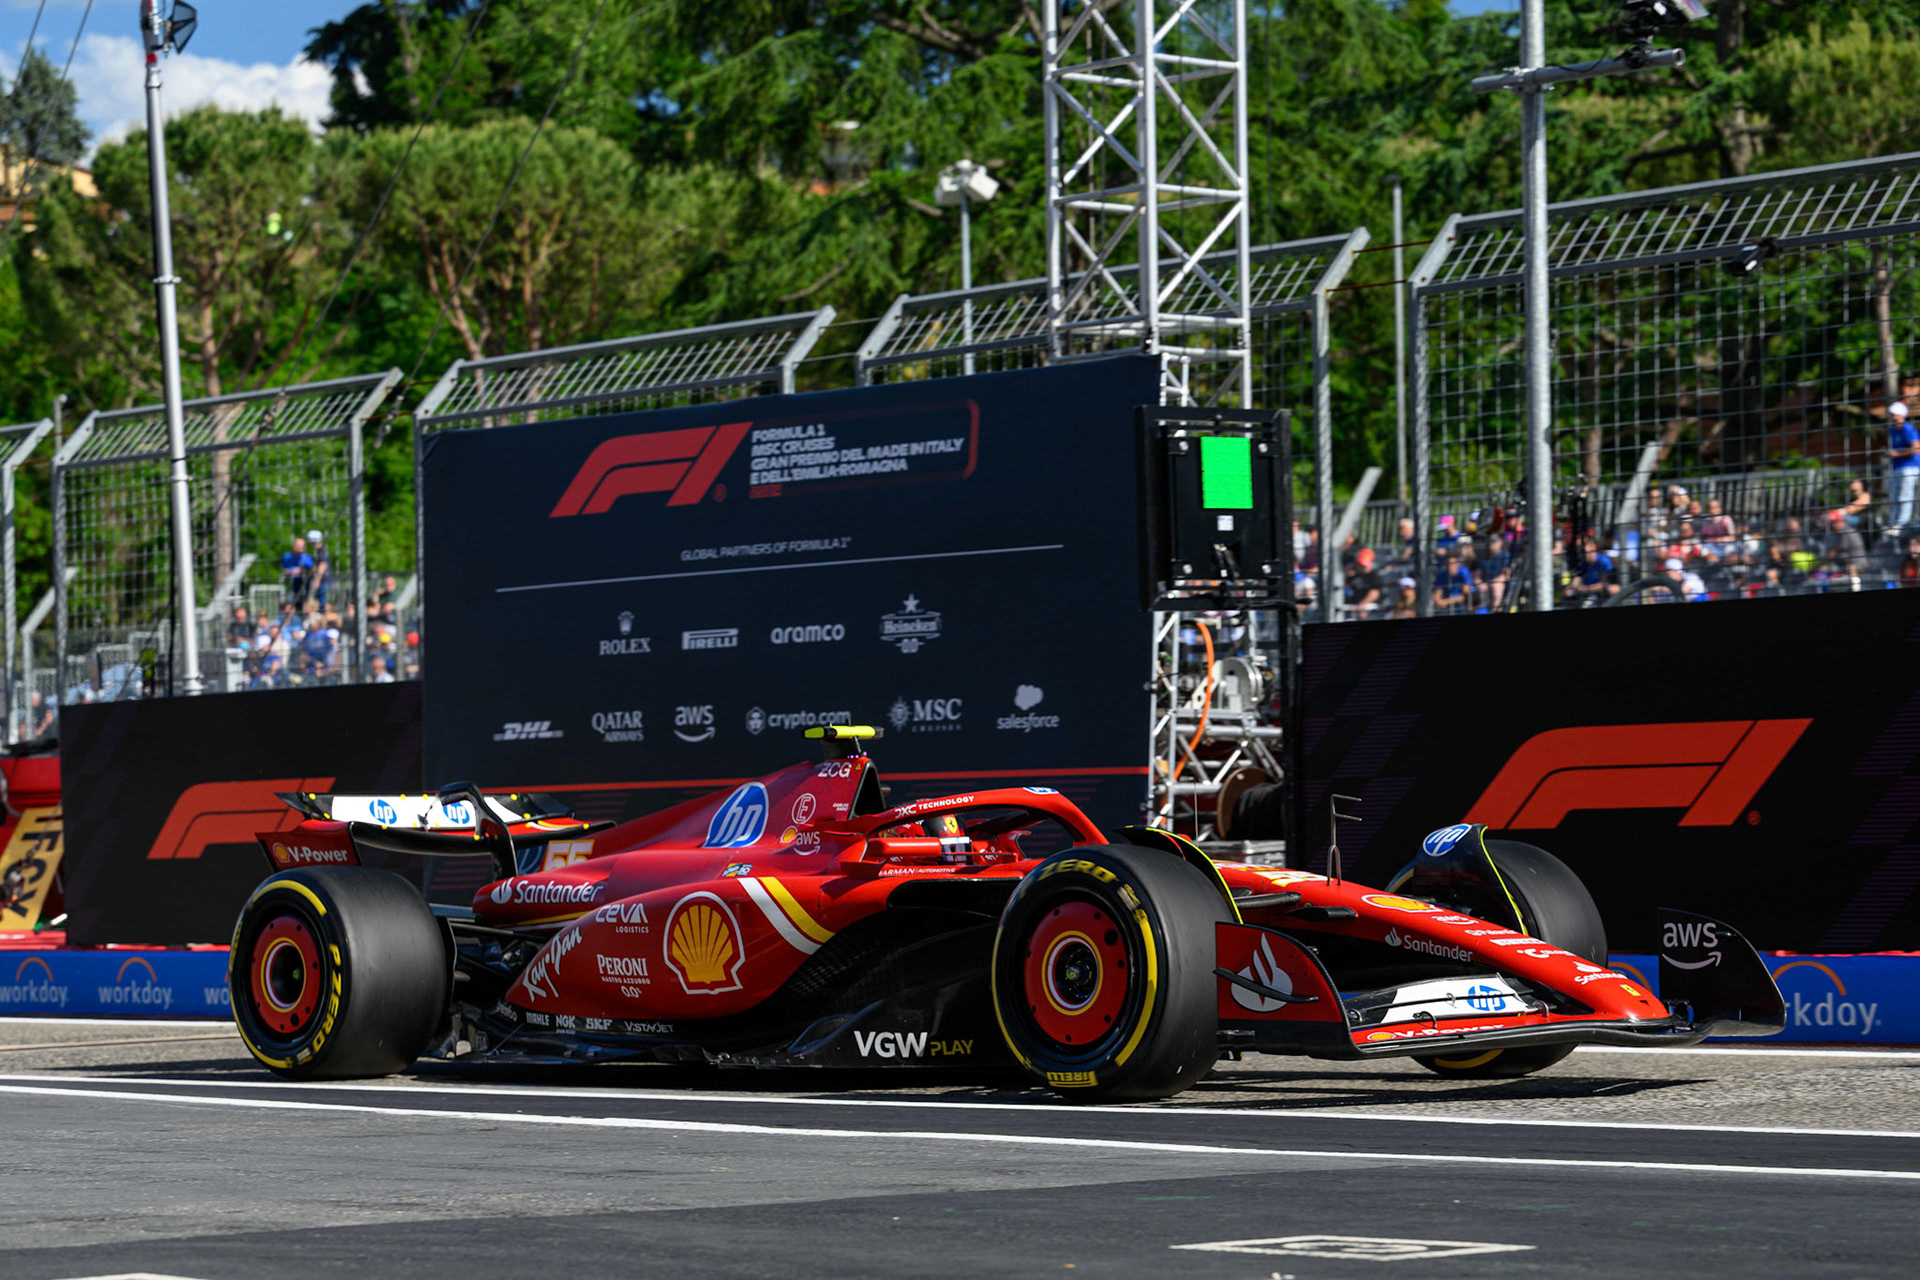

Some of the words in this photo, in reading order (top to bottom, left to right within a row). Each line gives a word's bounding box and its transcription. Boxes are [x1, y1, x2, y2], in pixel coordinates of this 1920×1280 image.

[751, 425, 818, 443] FORMULA
[817, 423, 826, 436] 1
[751, 442, 781, 457] MSC
[782, 436, 836, 453] CRUISES
[751, 456, 788, 471] GRAN
[790, 451, 839, 468] PREMIO
[841, 448, 866, 463] DEL
[868, 443, 908, 460] MADE
[909, 442, 924, 455] IN
[925, 438, 964, 453] ITALY
[750, 472, 759, 485] E
[680, 548, 720, 561] GLOBAL
[720, 543, 772, 557] PARTNERS
[773, 541, 788, 554] OF
[789, 538, 840, 552] FORMULA
[681, 628, 740, 650] PIRELLI
[770, 624, 846, 644] aramco
[599, 637, 651, 656] ROLEX
[674, 704, 714, 726] aws
[768, 710, 851, 729] crypto.com
[912, 698, 962, 721] MSC
[502, 720, 555, 740] DHL
[591, 710, 643, 733] QATAR
[996, 712, 1060, 733] salesforce
[603, 730, 644, 742] AIRWAYS
[818, 762, 852, 778] ZCG
[369, 799, 397, 825] hp
[443, 801, 470, 825] hp
[702, 782, 769, 849] hp
[895, 804, 917, 818] DXC
[918, 795, 974, 810] TECHNOLOGY
[796, 831, 820, 845] aws
[1423, 823, 1472, 857] hp
[287, 846, 348, 863] V-Power
[543, 839, 595, 872] 55
[917, 867, 956, 875] AUTOMOTIVE
[1037, 859, 1120, 883] ZERO
[514, 880, 604, 905] Santander
[615, 926, 649, 934] LOGISTICS
[1663, 921, 1717, 948] aws
[329, 943, 342, 967] P
[1403, 934, 1474, 962] Santander
[596, 954, 648, 976] PERONI
[601, 976, 622, 984] NASTRO
[623, 977, 651, 985] AZZURRO
[1467, 985, 1506, 1011] hp
[312, 970, 342, 1053] ZERO
[526, 1012, 549, 1026] MAHLE
[555, 1014, 576, 1029] NGK
[586, 1018, 613, 1031] SKF
[1395, 1023, 1504, 1039] V-Power
[854, 1030, 928, 1058] VGW
[930, 1039, 974, 1057] PLAY
[1045, 1071, 1098, 1088] PIRELLI
